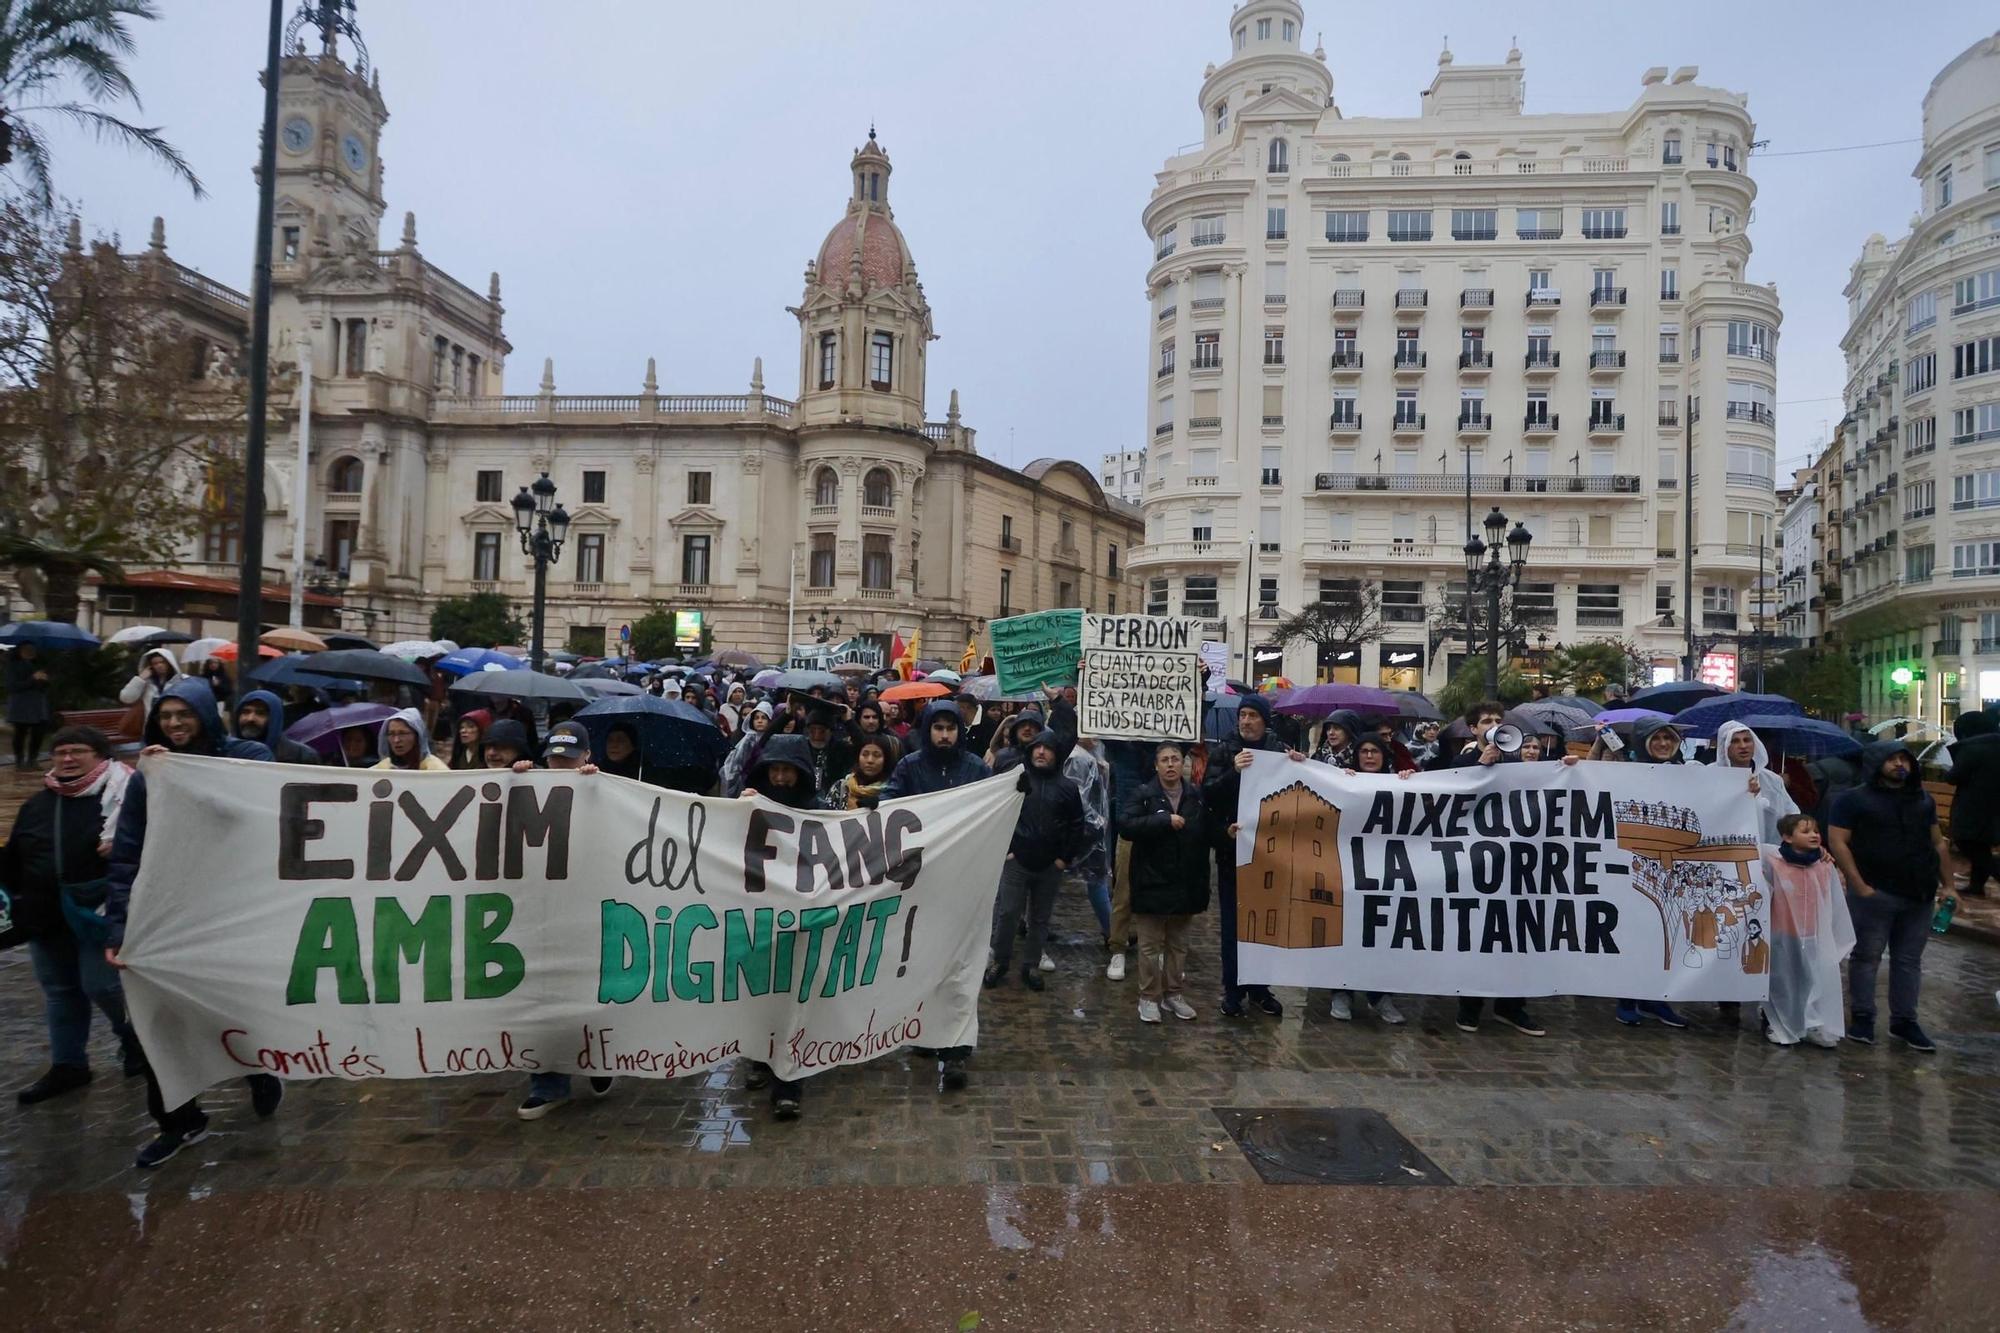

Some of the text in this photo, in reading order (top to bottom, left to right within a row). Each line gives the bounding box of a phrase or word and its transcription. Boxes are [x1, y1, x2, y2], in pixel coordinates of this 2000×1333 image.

[1088, 671, 1192, 692] CUESTA DECIR
[1089, 653, 1156, 672] CUANTO
[1163, 657, 1187, 673] OS
[1088, 691, 1185, 711] ESA PALABRA
[1088, 709, 1130, 729] HIJOS
[1362, 789, 1616, 840] AIXEQUEM
[625, 796, 705, 894] del
[744, 808, 924, 892] FANG
[1350, 836, 1630, 895] LA TORRE-
[286, 892, 526, 1006] AMB
[1362, 894, 1620, 954] FAITANAR
[220, 1001, 924, 1078] Comités Locals d'Emergència i Reconstrucció
